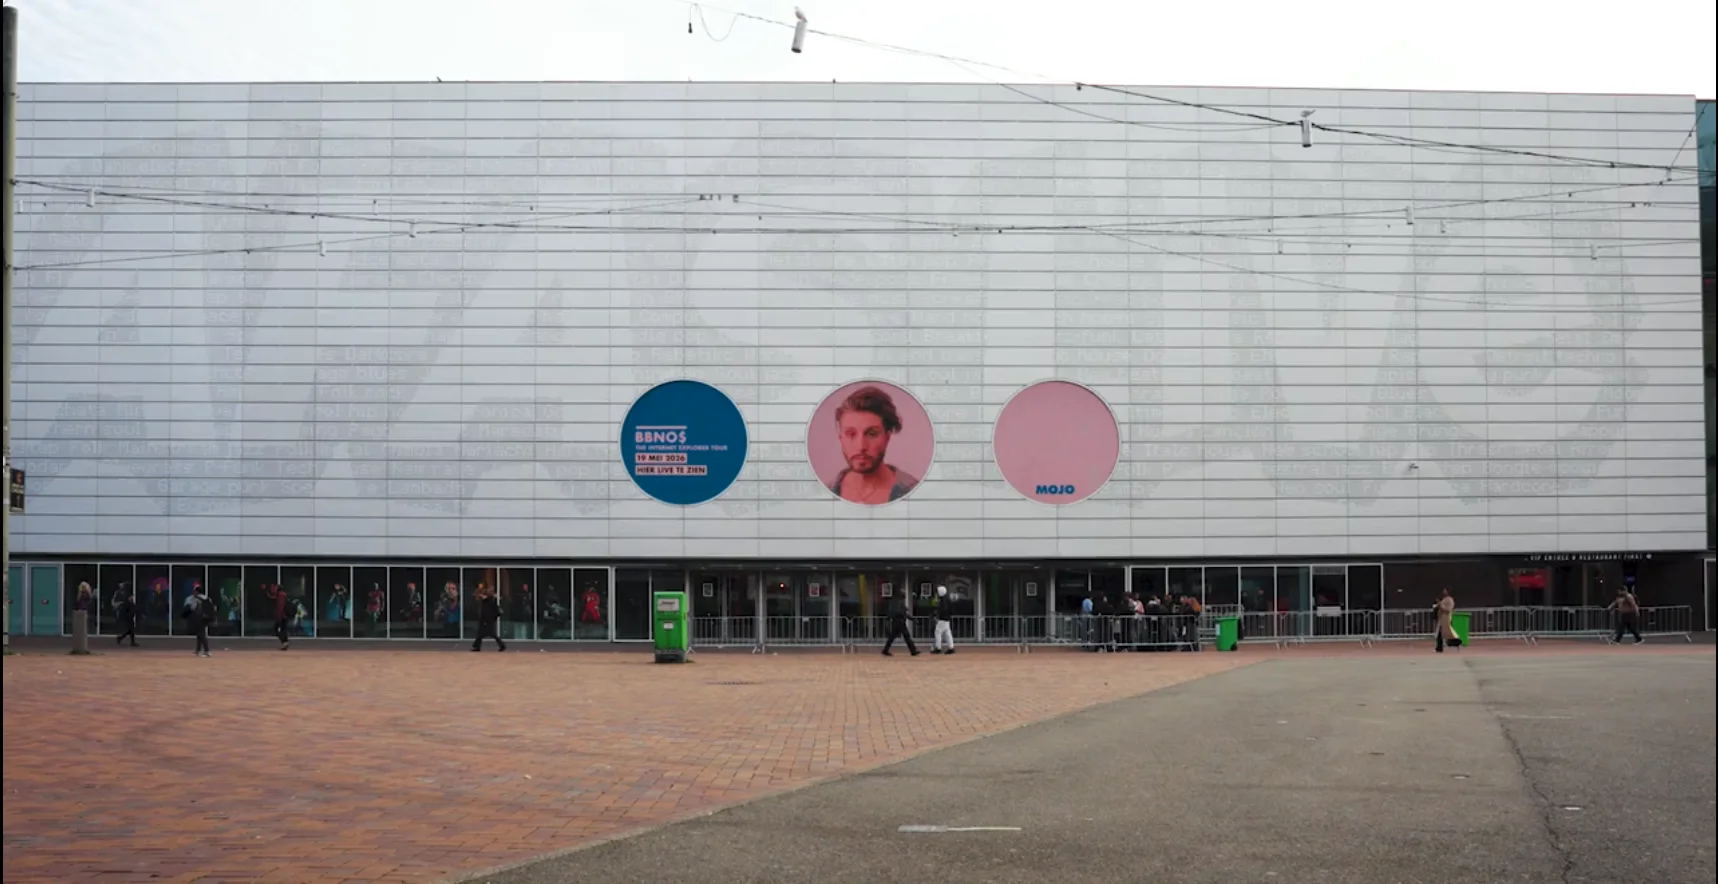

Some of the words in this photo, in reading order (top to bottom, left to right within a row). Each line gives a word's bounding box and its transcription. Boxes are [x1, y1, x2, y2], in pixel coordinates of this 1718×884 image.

[635, 430, 687, 444] BBNO$
[637, 466, 655, 474] HIER
[658, 466, 674, 474] LIVE
[676, 466, 685, 474] TE
[687, 466, 706, 474] ZIEN
[1035, 484, 1076, 495] MOJO
